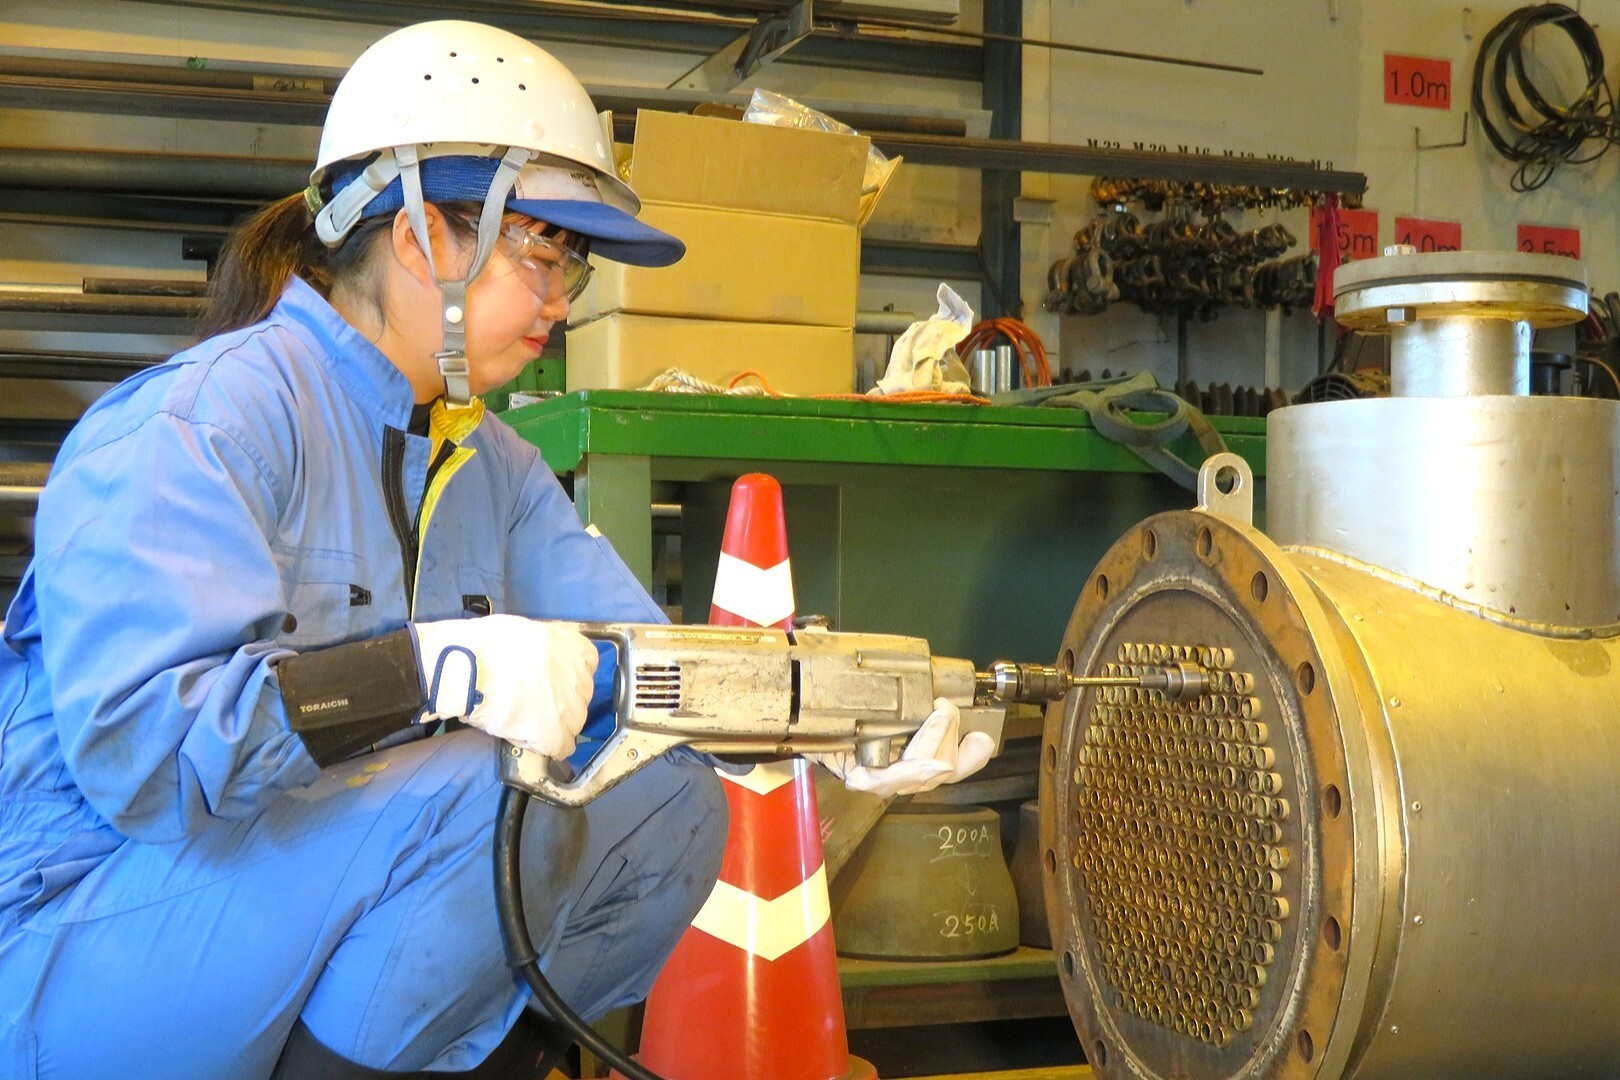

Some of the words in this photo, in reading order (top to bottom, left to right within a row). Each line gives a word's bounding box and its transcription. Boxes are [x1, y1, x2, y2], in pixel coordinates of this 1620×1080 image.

[1391, 70, 1447, 101] 1.0m
[300, 698, 349, 713] TORAICHI
[938, 825, 989, 850] 200A
[940, 913, 999, 938] 250A
